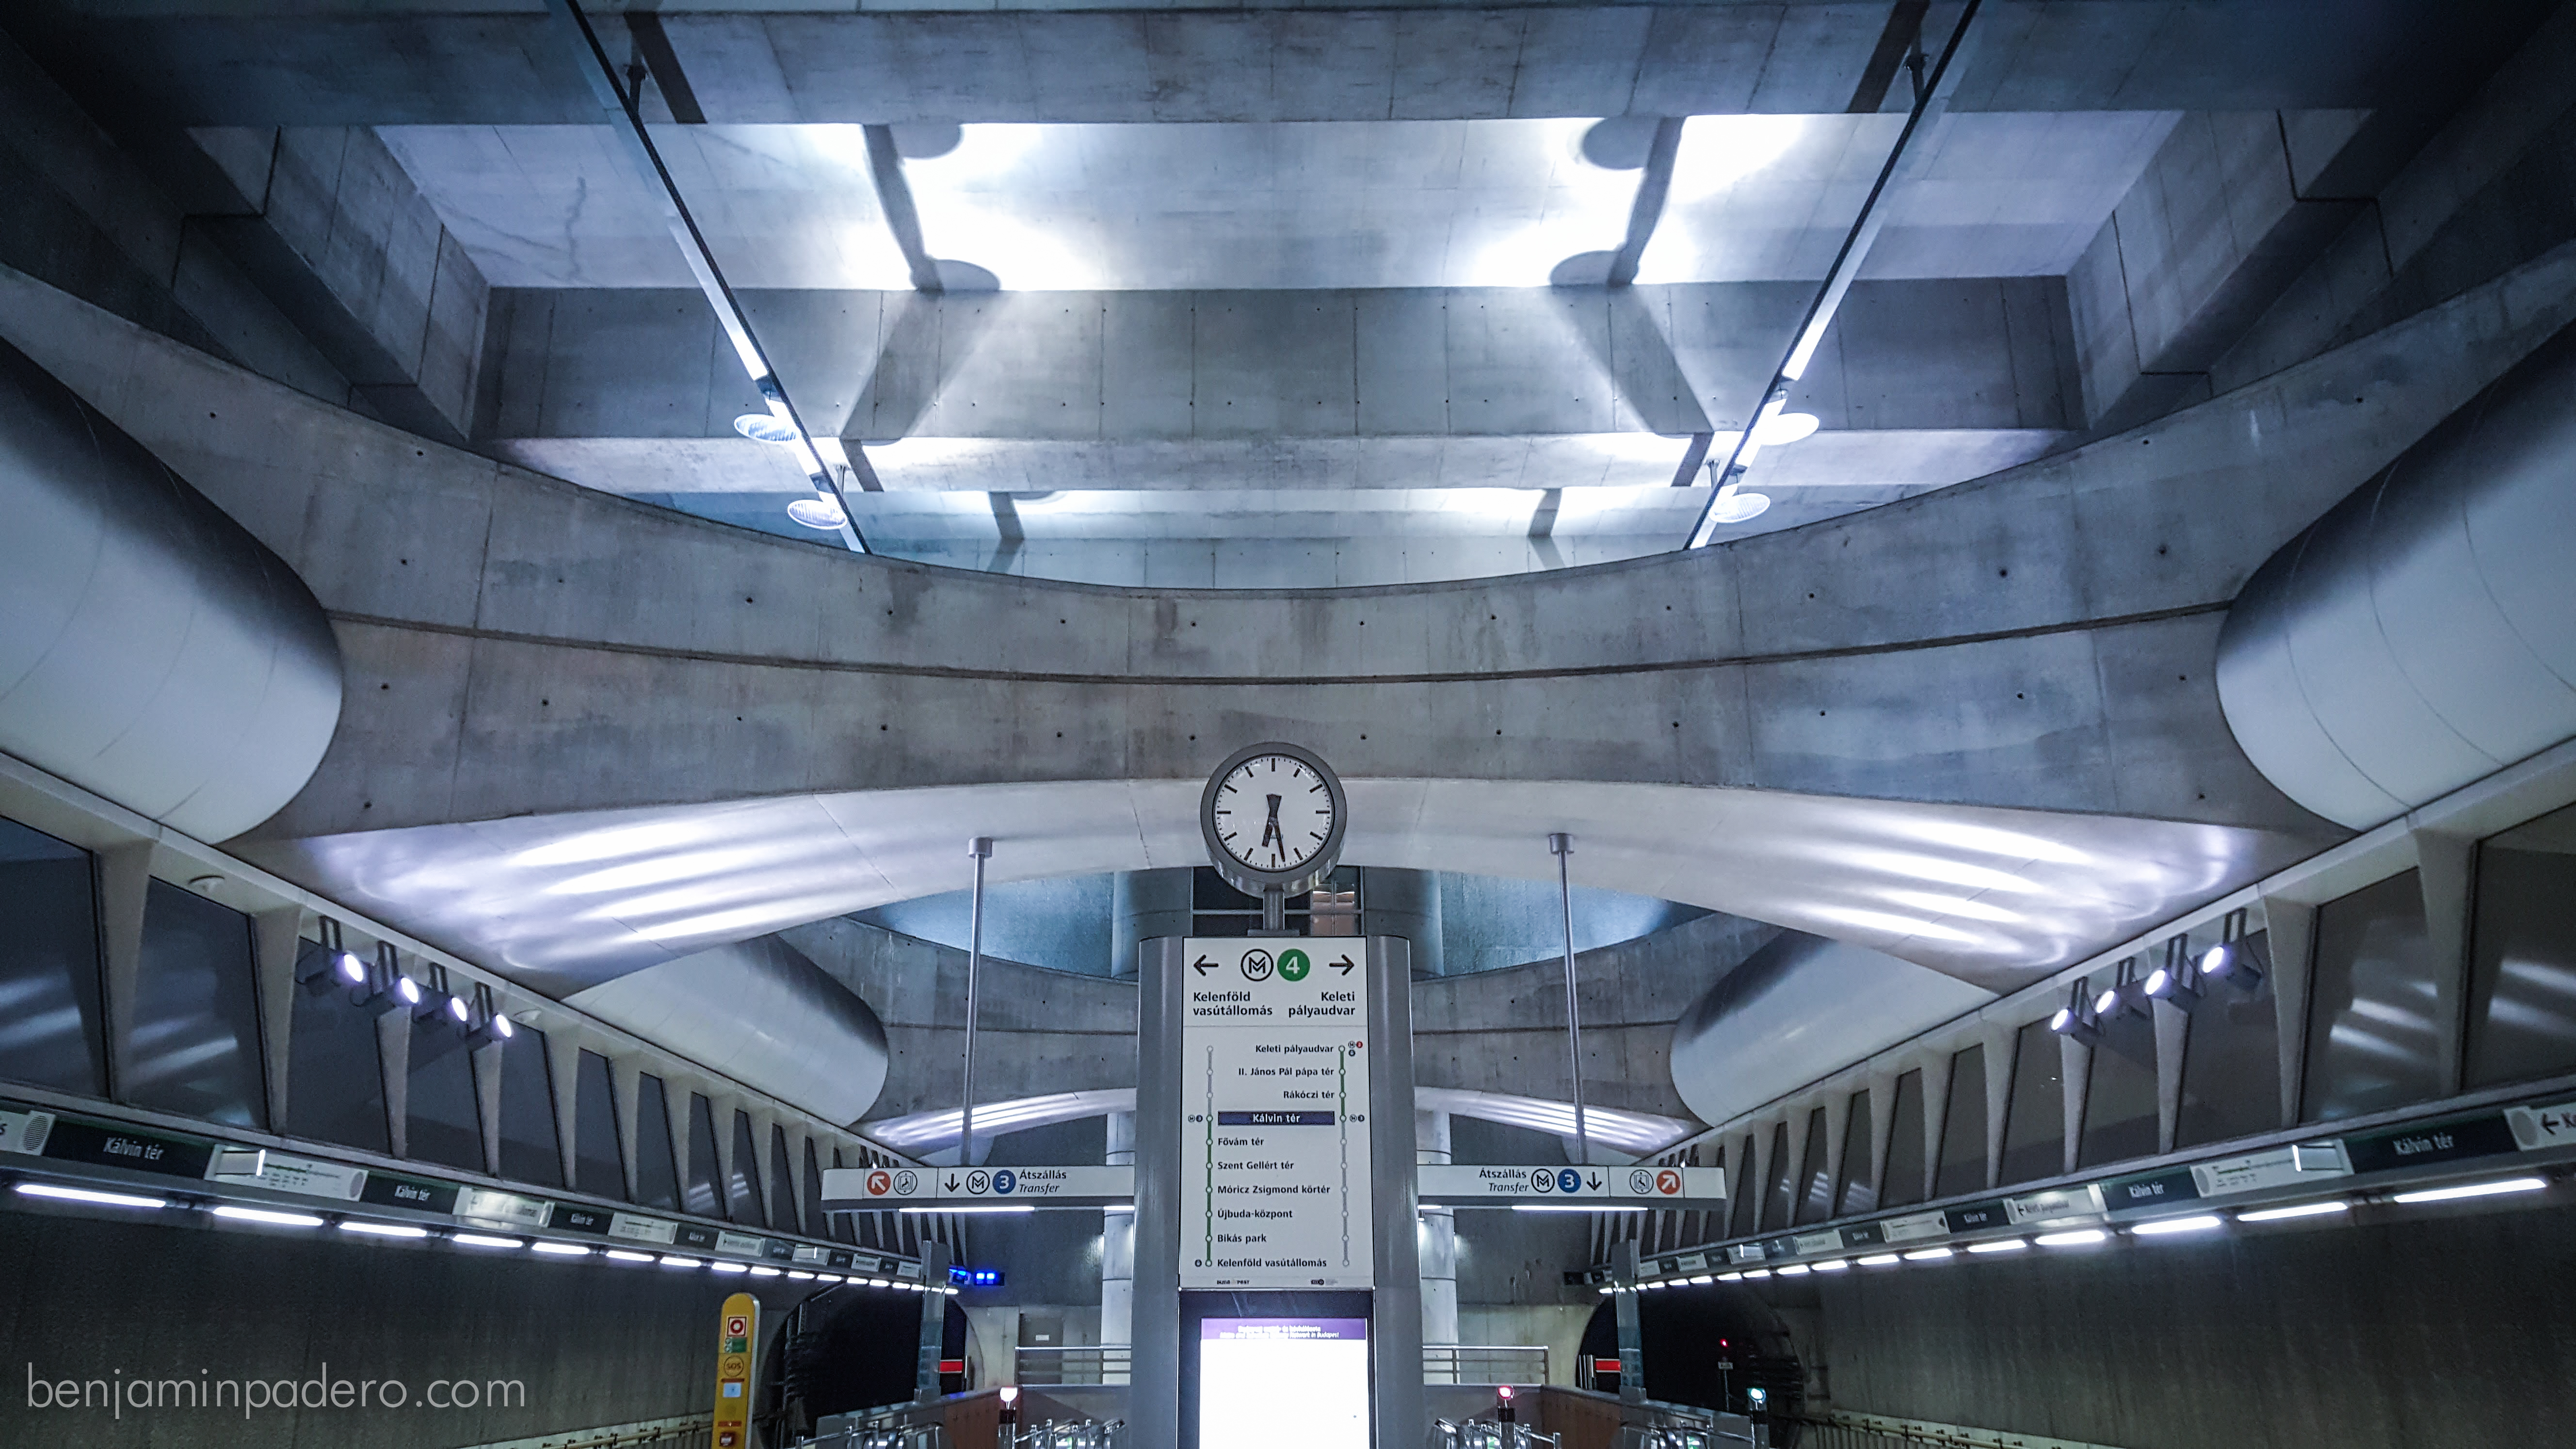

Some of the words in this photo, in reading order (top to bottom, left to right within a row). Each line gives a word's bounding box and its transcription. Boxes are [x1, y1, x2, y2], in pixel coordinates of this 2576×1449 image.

[1286, 956, 1300, 974] 4
[1193, 991, 1250, 1002] Kelenföld
[1321, 991, 1355, 1001] Keleti
[1193, 1005, 1272, 1015] vasútállomás
[1288, 1004, 1355, 1018] pályaudvar
[1284, 1044, 1334, 1055] pályaudvar
[1251, 1067, 1276, 1076] János
[1279, 1067, 1292, 1076] Pál
[1296, 1067, 1318, 1078] pápa
[1321, 1067, 1334, 1076] tér
[1284, 1090, 1318, 1099] Rákóczi
[1321, 1090, 1335, 1098] tér
[1252, 1113, 1282, 1123] Kálvin
[1286, 1113, 1300, 1123] tér
[1218, 1137, 1248, 1146] Fővám
[1251, 1137, 1264, 1145] tér
[2393, 1136, 2433, 1155] Kálvin
[2432, 1132, 2454, 1149] tér
[103, 1137, 143, 1158] Kálvin
[144, 1144, 164, 1160] tér
[1218, 1161, 1243, 1170] Szent
[1246, 1161, 1277, 1169] Gellért
[1281, 1161, 1294, 1169] tér
[999, 1175, 1009, 1189] 3
[1019, 1169, 1066, 1179] Átszállás
[1479, 1167, 1527, 1178] Átszállás
[1564, 1174, 1575, 1188] 3
[1019, 1183, 1060, 1195] Transfer
[1218, 1185, 1249, 1194] Móricz
[1253, 1185, 1298, 1195] Zsigmond
[1302, 1185, 1330, 1193] körtér
[1489, 1182, 1529, 1194] Transfer
[1218, 1208, 1293, 1220] Újbuda-központ
[1218, 1233, 1242, 1242] Bikás
[1245, 1233, 1266, 1244] park
[1217, 1258, 1262, 1267] Kelenföld
[1265, 1258, 1327, 1267] vasútállomás
